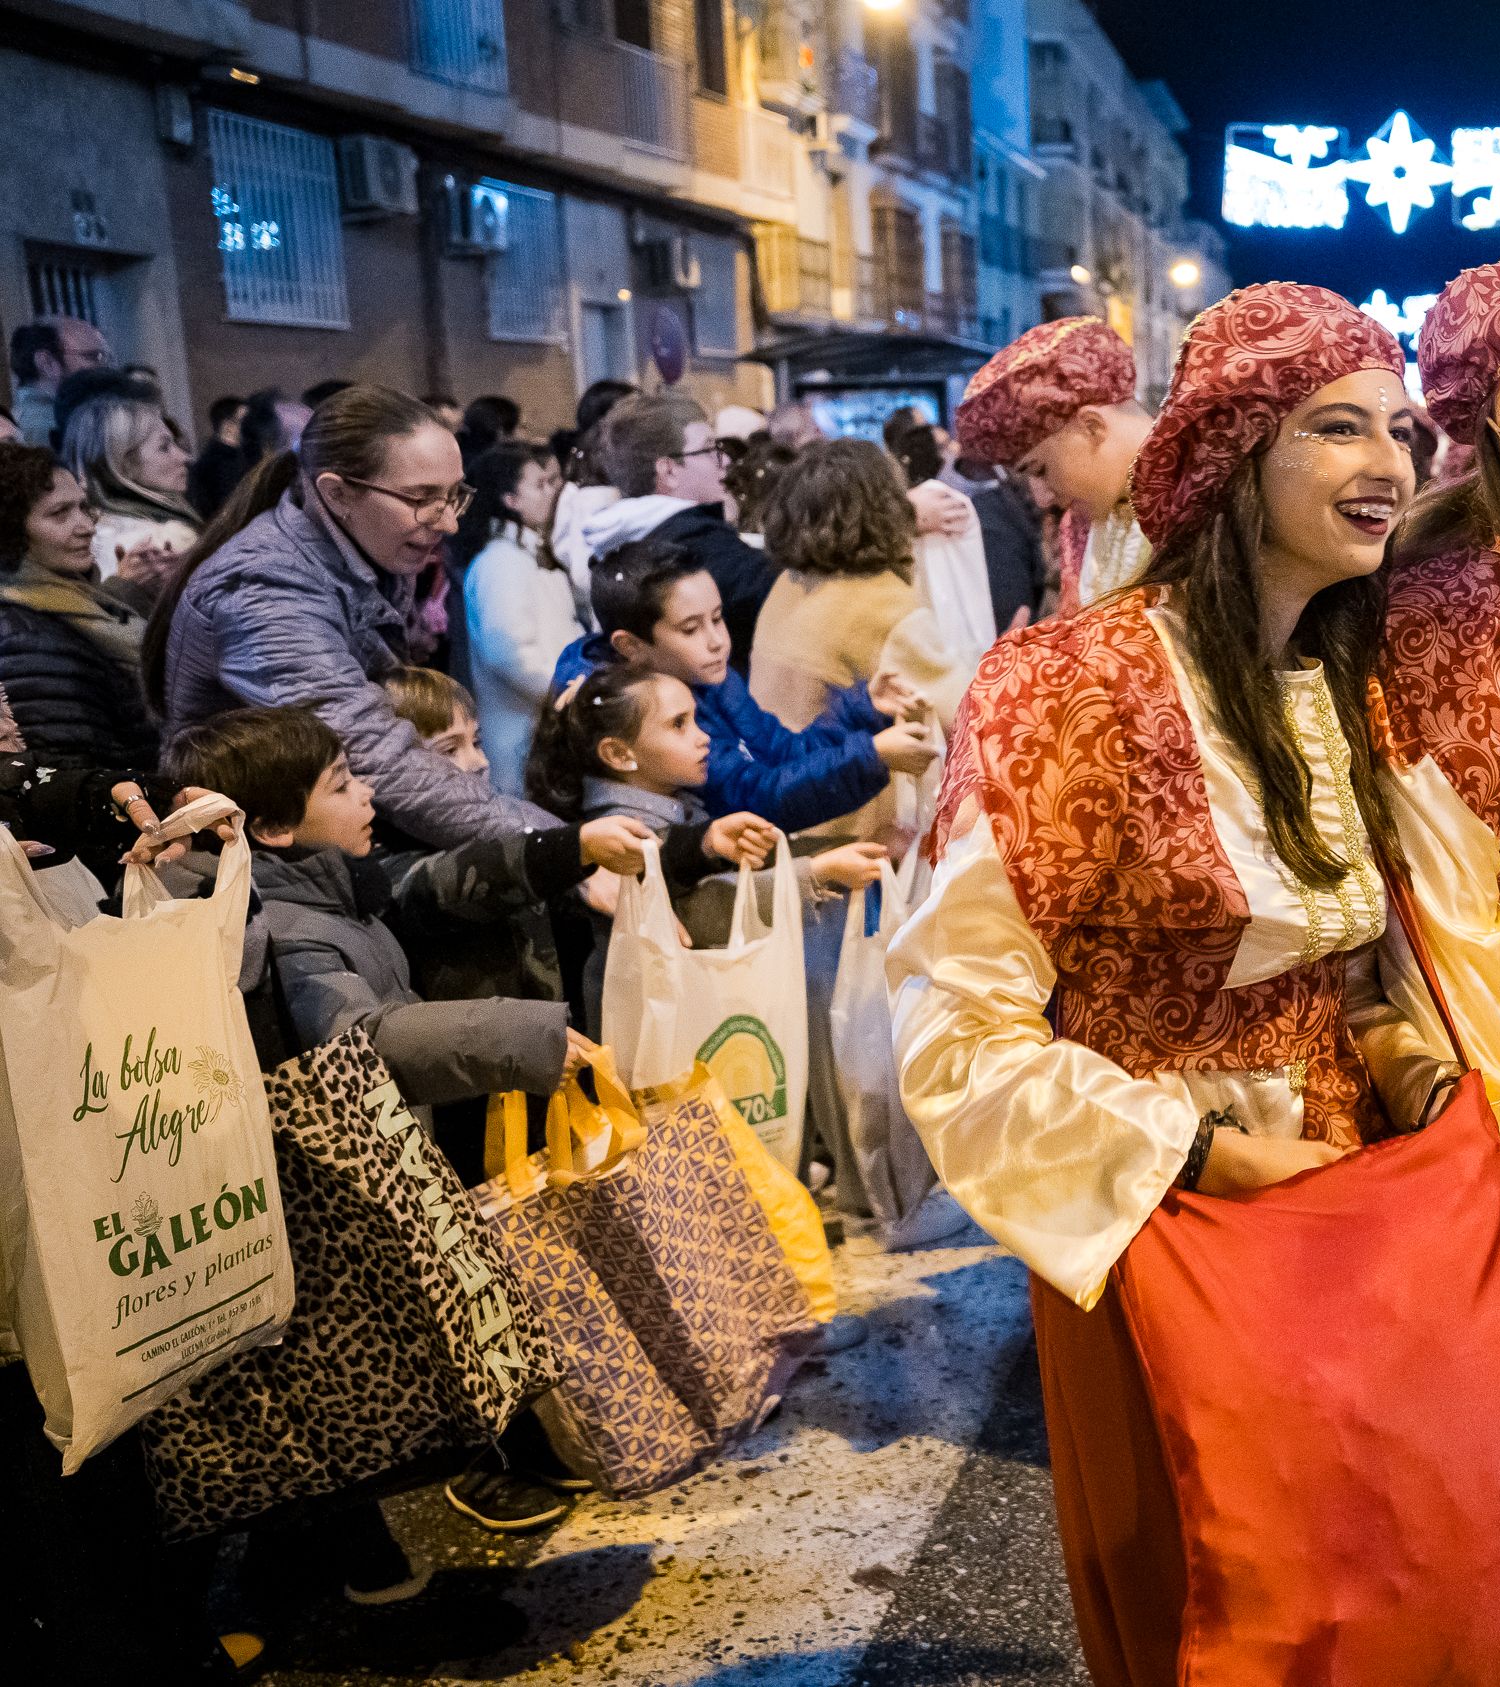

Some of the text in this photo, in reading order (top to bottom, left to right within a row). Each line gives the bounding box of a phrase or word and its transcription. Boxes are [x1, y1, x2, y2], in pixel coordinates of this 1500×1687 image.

[73, 1027, 182, 1122] La bolsa
[110, 1088, 210, 1183] Alegre
[93, 1211, 125, 1242] EL
[108, 1177, 268, 1278] GALEÓN
[363, 1079, 531, 1393] ZEEMAN
[112, 1234, 273, 1329] flores y plantas
[141, 1341, 171, 1362] CAMINO
[171, 1337, 179, 1348] EL
[181, 1340, 204, 1360] LUCENA
